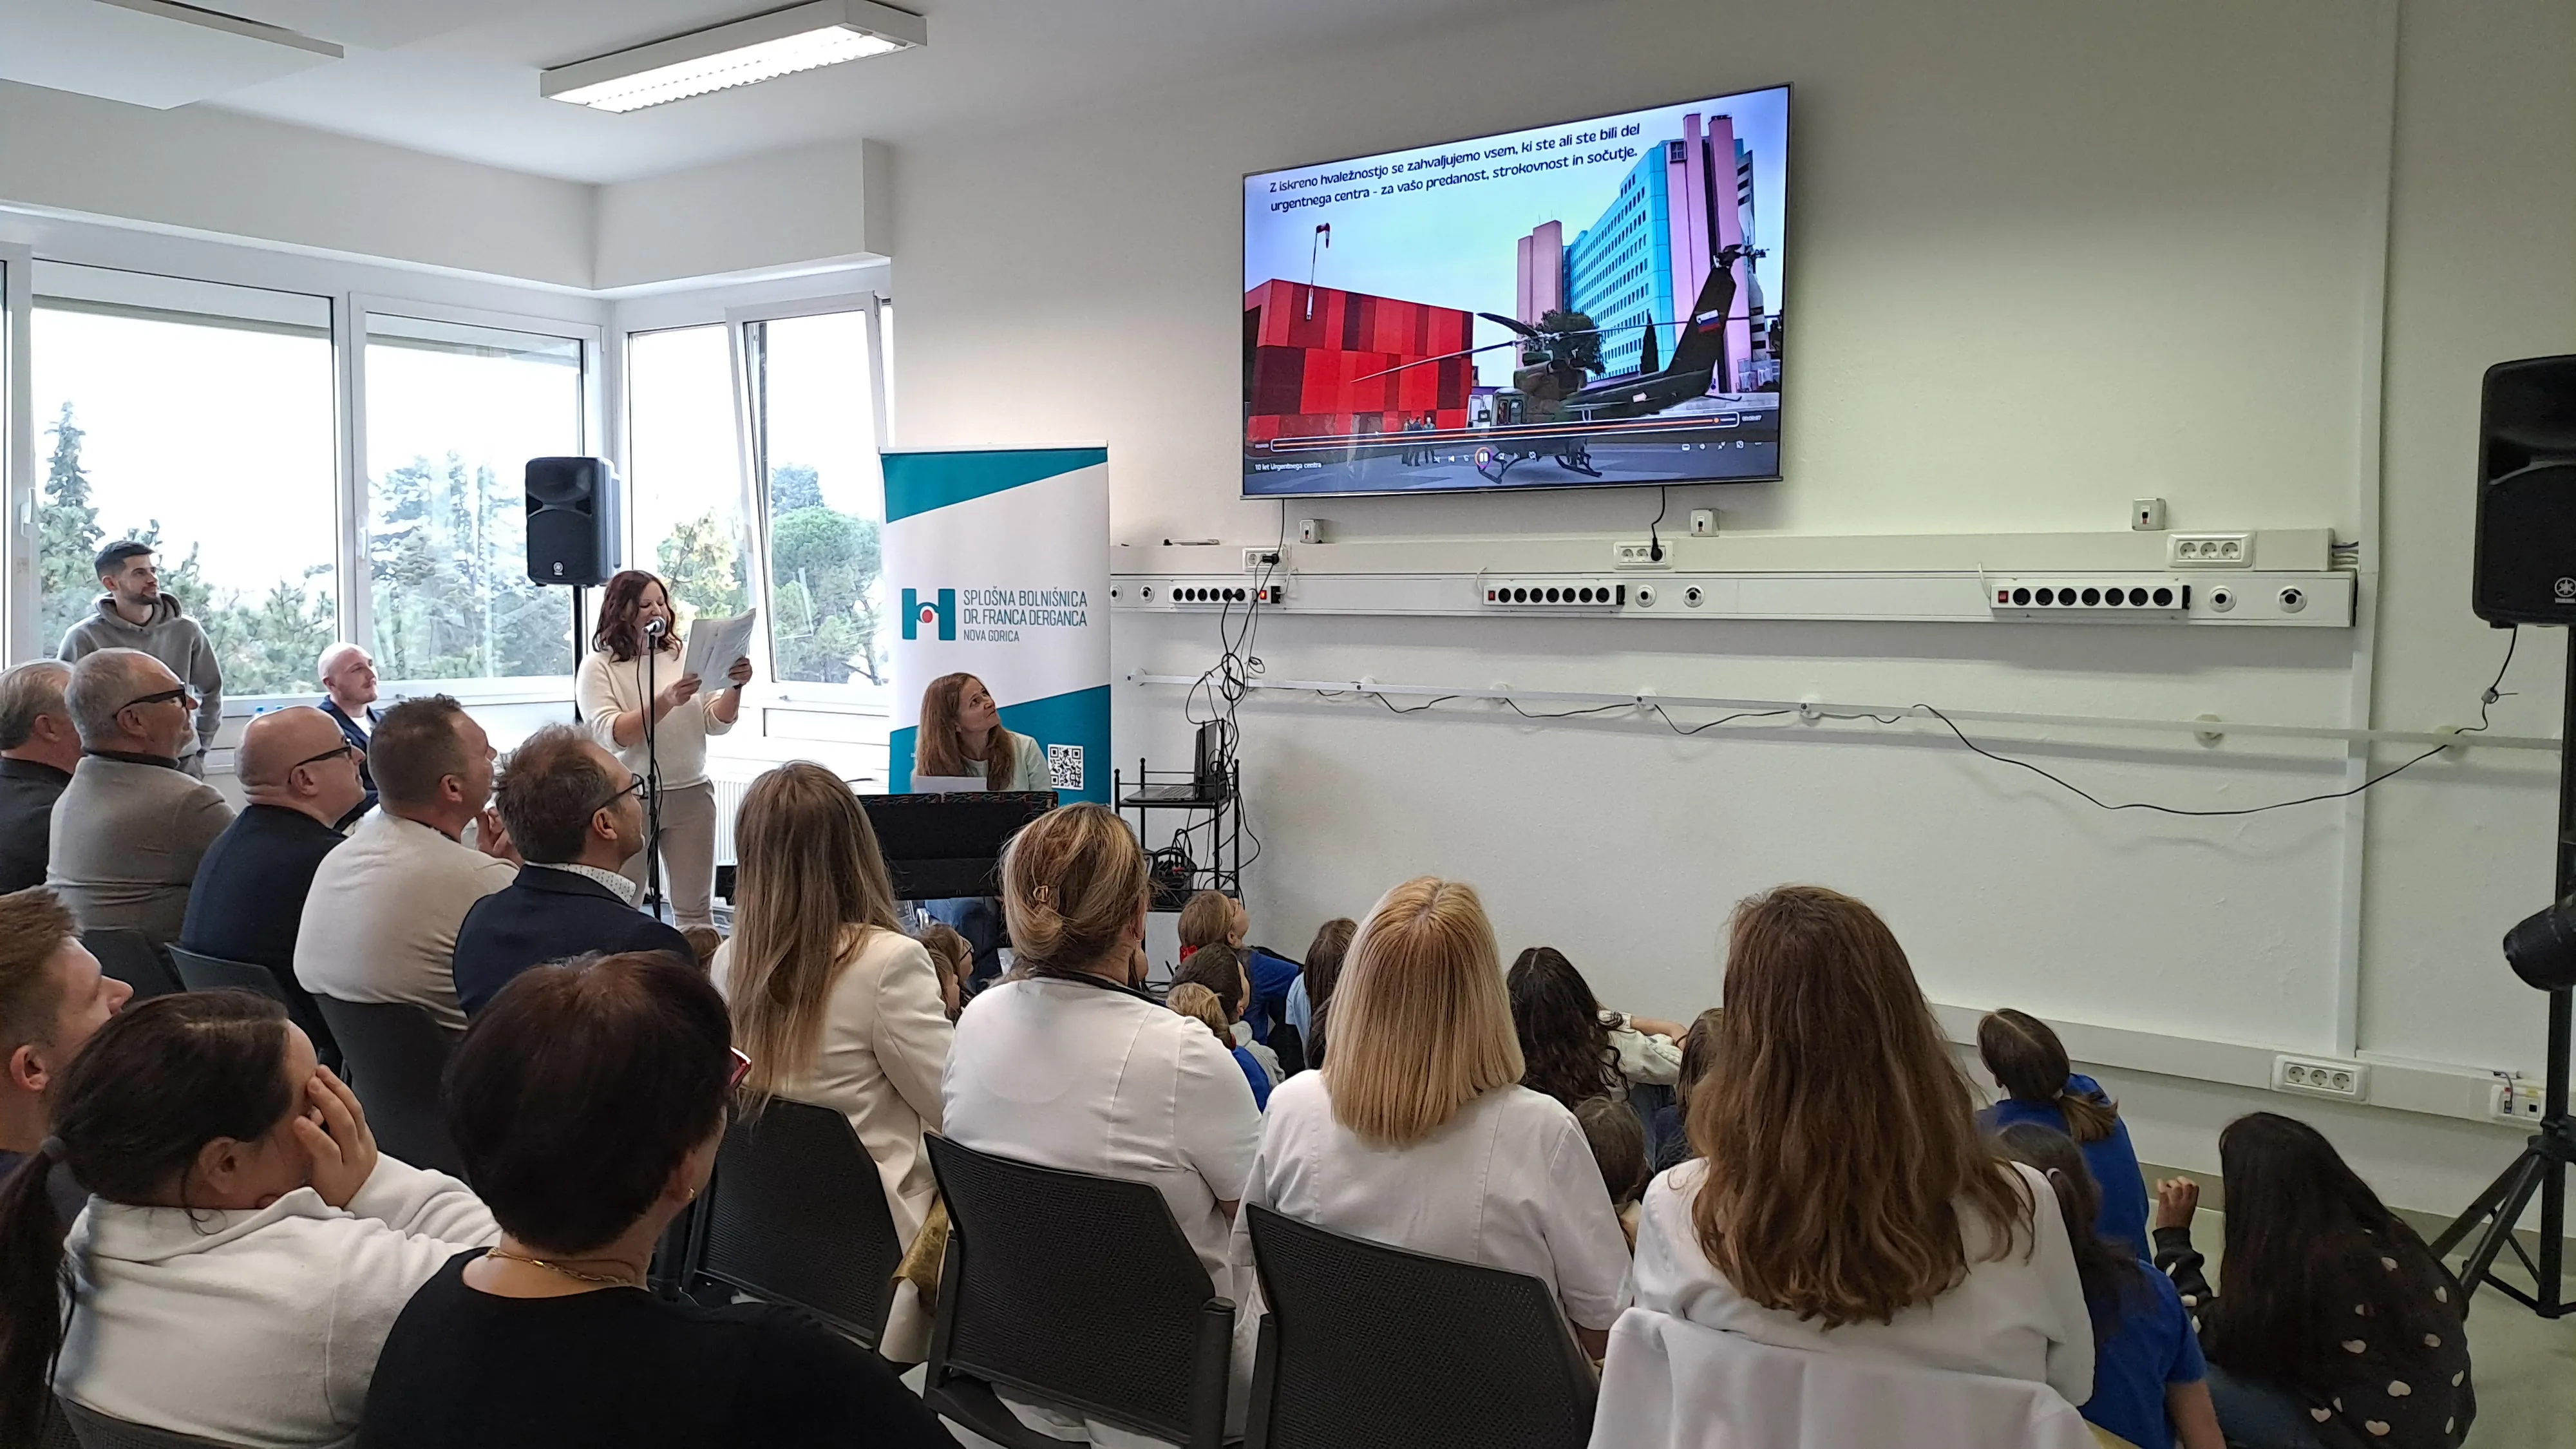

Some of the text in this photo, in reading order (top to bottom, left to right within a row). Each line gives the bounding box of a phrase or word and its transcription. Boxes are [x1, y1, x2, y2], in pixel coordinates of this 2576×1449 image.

[1270, 123, 1640, 193] Z iskreno hvaležnostjo se zahvaljujemo vsem, ki ste ali ste bili del
[1271, 194, 1332, 213] urgentnega
[1334, 189, 1370, 202] centra
[1381, 185, 1394, 195] za
[1397, 180, 1423, 193] vašo
[1426, 169, 1489, 191] predanost,
[1493, 156, 1569, 178] strokovnost
[1572, 155, 1584, 166] in
[1587, 147, 1638, 164] sočutje.
[963, 585, 1088, 607] SPLOŠNA BOLNIŠNICA
[963, 609, 1088, 627] DR. FRANCA DERGANCA
[963, 629, 1019, 642] NOVA GORICA
